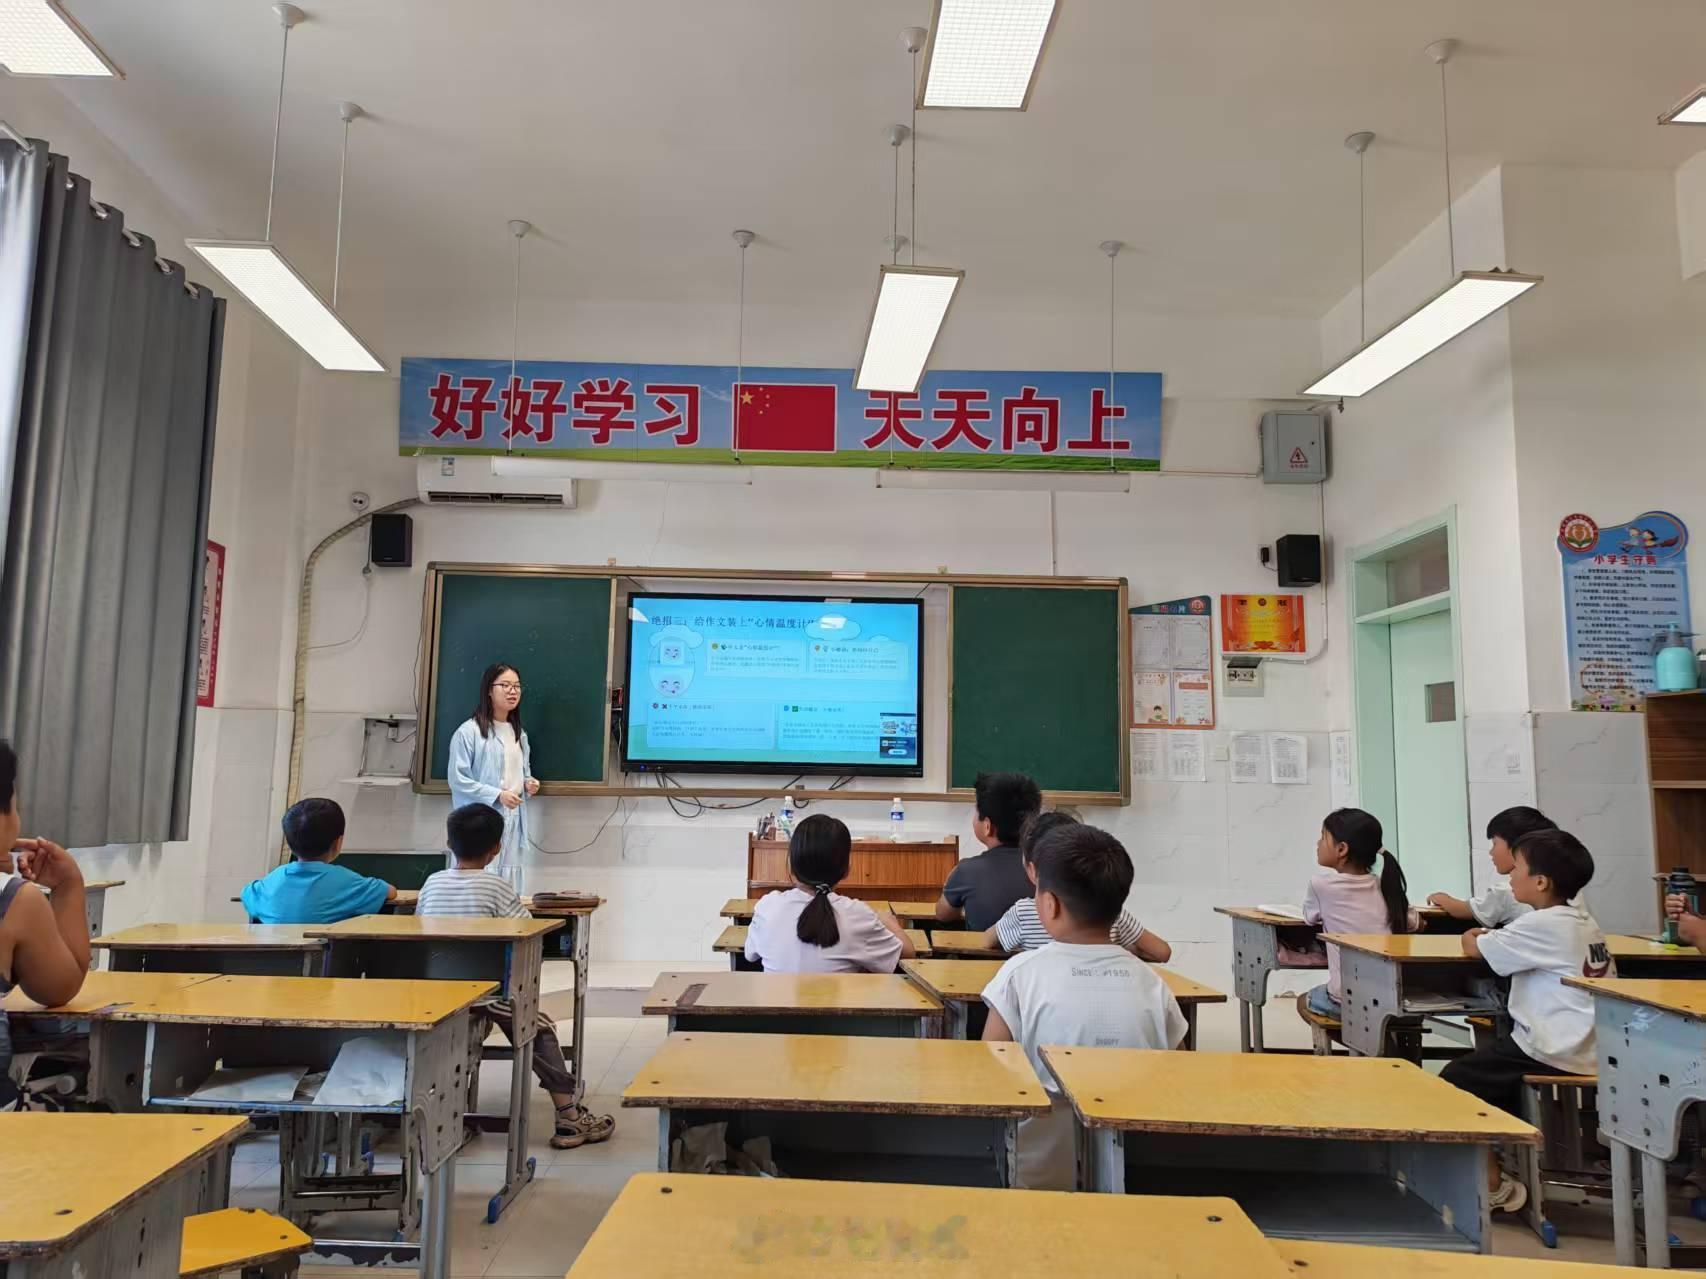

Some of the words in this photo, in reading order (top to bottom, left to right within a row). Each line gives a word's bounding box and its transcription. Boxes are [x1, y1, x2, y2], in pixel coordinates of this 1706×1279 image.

[429, 373, 701, 447] 好好学习
[861, 386, 1132, 453] 天天向上
